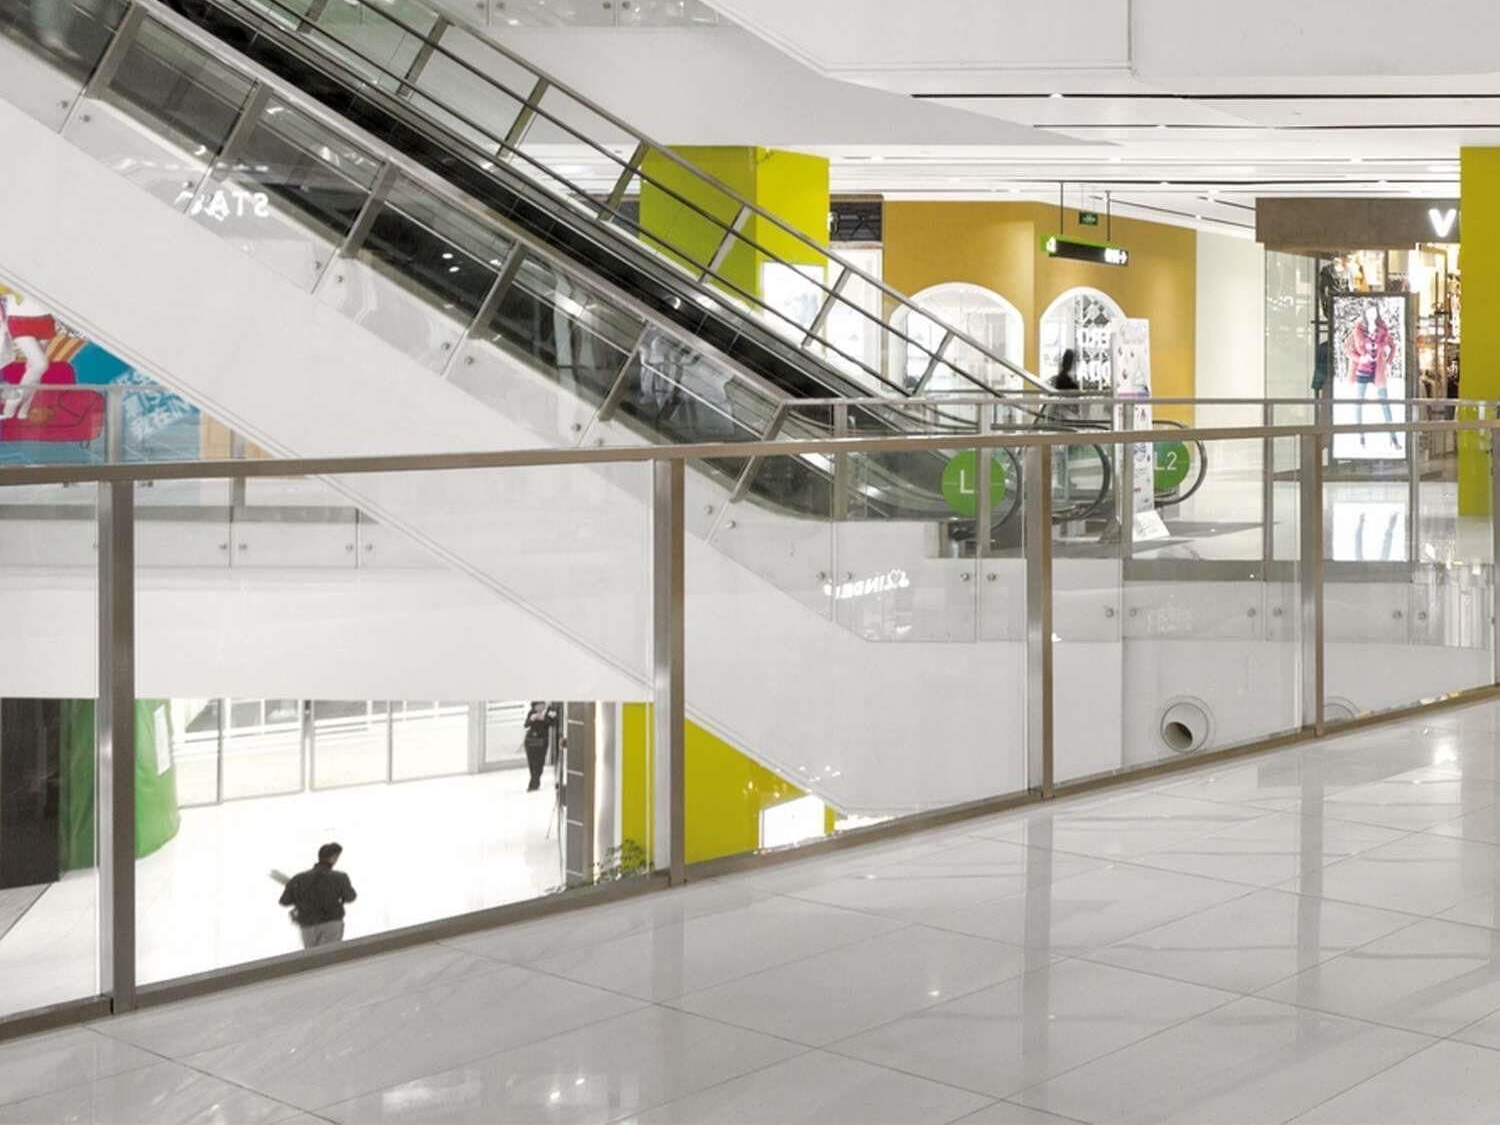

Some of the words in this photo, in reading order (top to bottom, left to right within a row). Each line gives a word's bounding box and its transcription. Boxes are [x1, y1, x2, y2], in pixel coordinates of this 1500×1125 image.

[1428, 208, 1461, 239] V
[1153, 451, 1178, 471] L2
[959, 469, 975, 494] L
